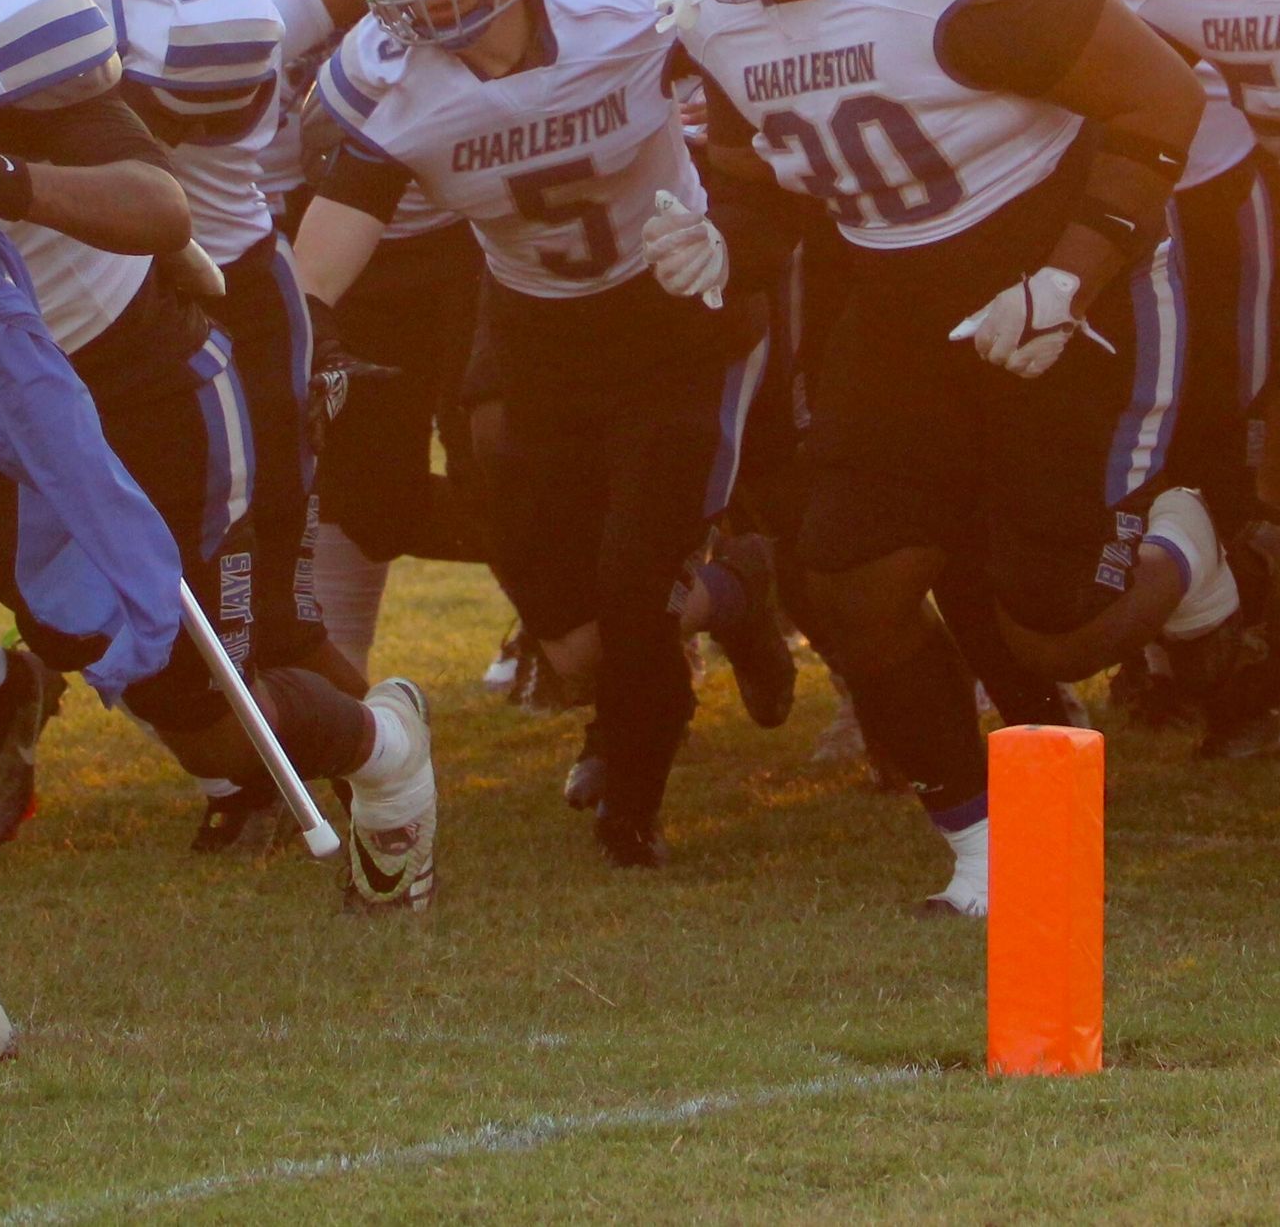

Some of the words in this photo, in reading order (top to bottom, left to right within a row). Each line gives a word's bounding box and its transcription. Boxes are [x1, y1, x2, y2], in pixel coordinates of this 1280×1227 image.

[743, 40, 877, 103] CHARLESTON
[451, 88, 628, 173] CHARLESTON
[502, 156, 620, 278] 5
[220, 552, 254, 624] JAYS
